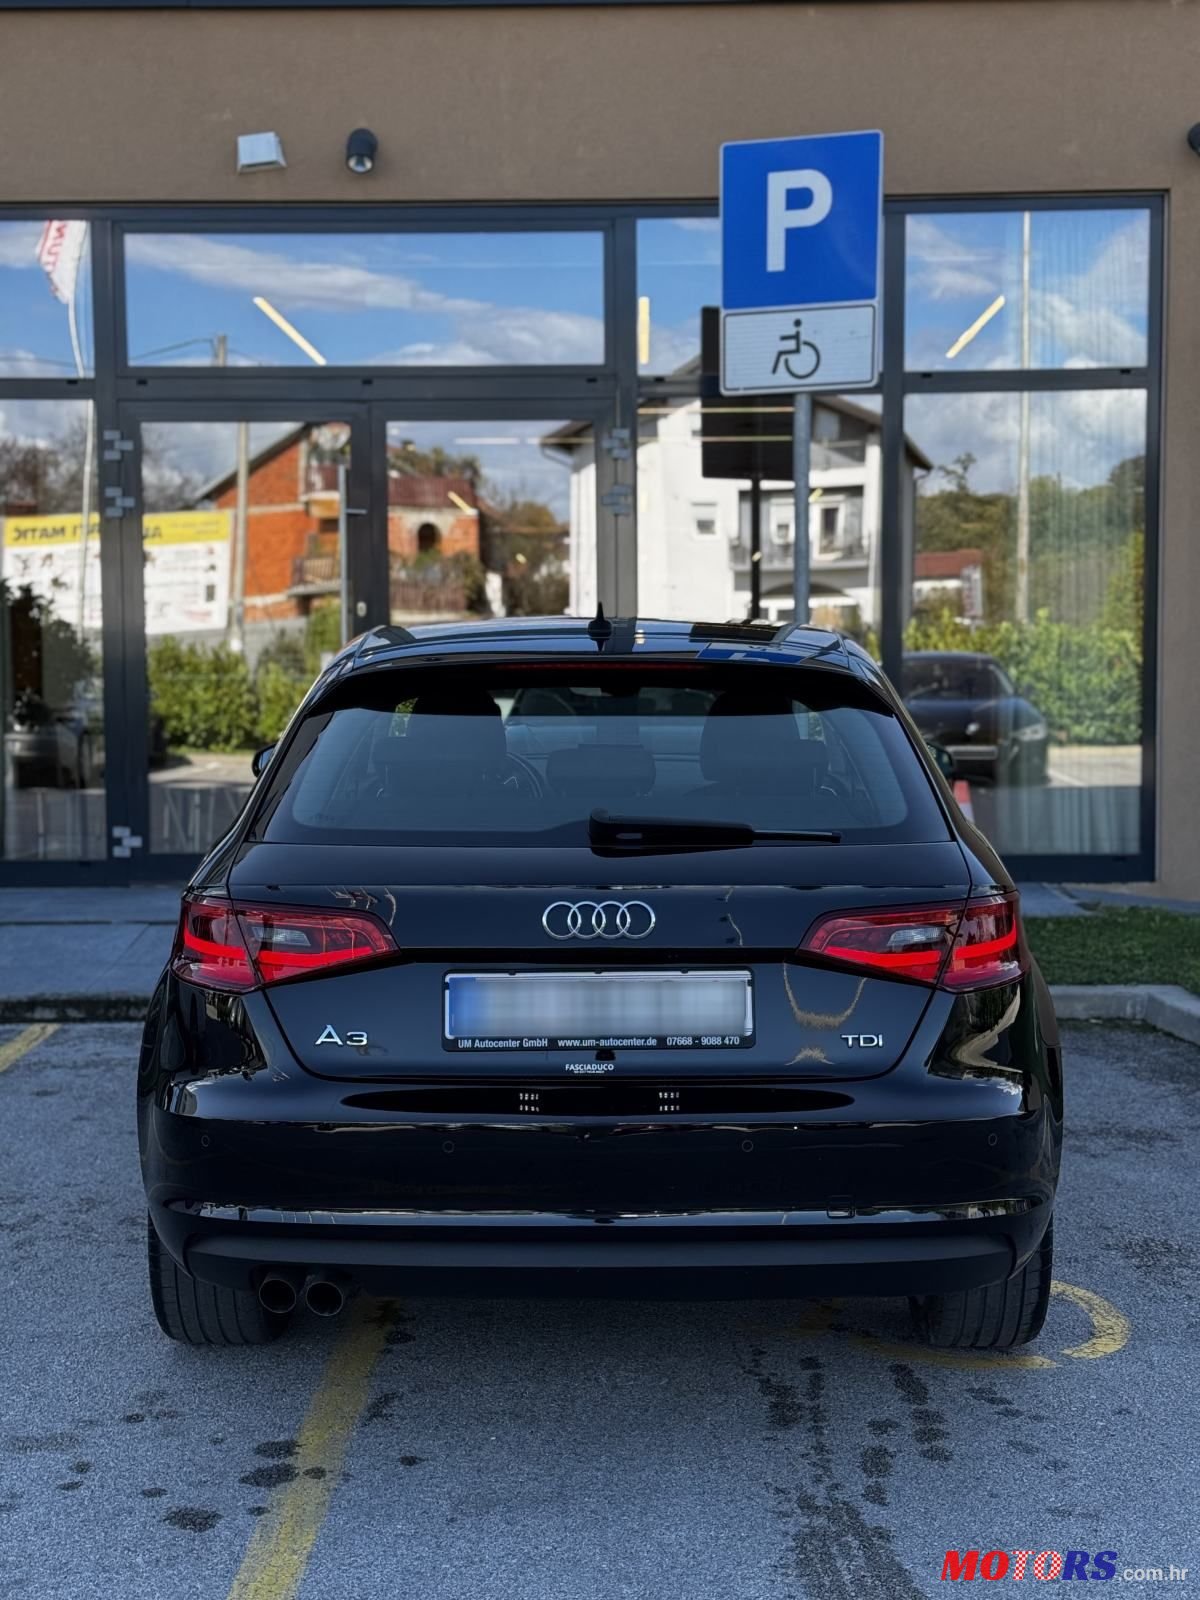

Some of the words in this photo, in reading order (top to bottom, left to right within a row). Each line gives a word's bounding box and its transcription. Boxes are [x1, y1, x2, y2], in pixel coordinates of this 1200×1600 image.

[766, 169, 833, 272] P
[315, 1024, 368, 1046] A3
[841, 1034, 883, 1047] TDI
[458, 1039, 472, 1049] UM
[474, 1039, 521, 1049] Autocenter
[522, 1038, 548, 1048] GmbH
[557, 1037, 657, 1047] www.um-autocenter.de
[666, 1036, 693, 1046] 07668
[701, 1036, 722, 1046] 9088
[723, 1036, 740, 1045] 470
[565, 1063, 614, 1071] FASCIADUCO
